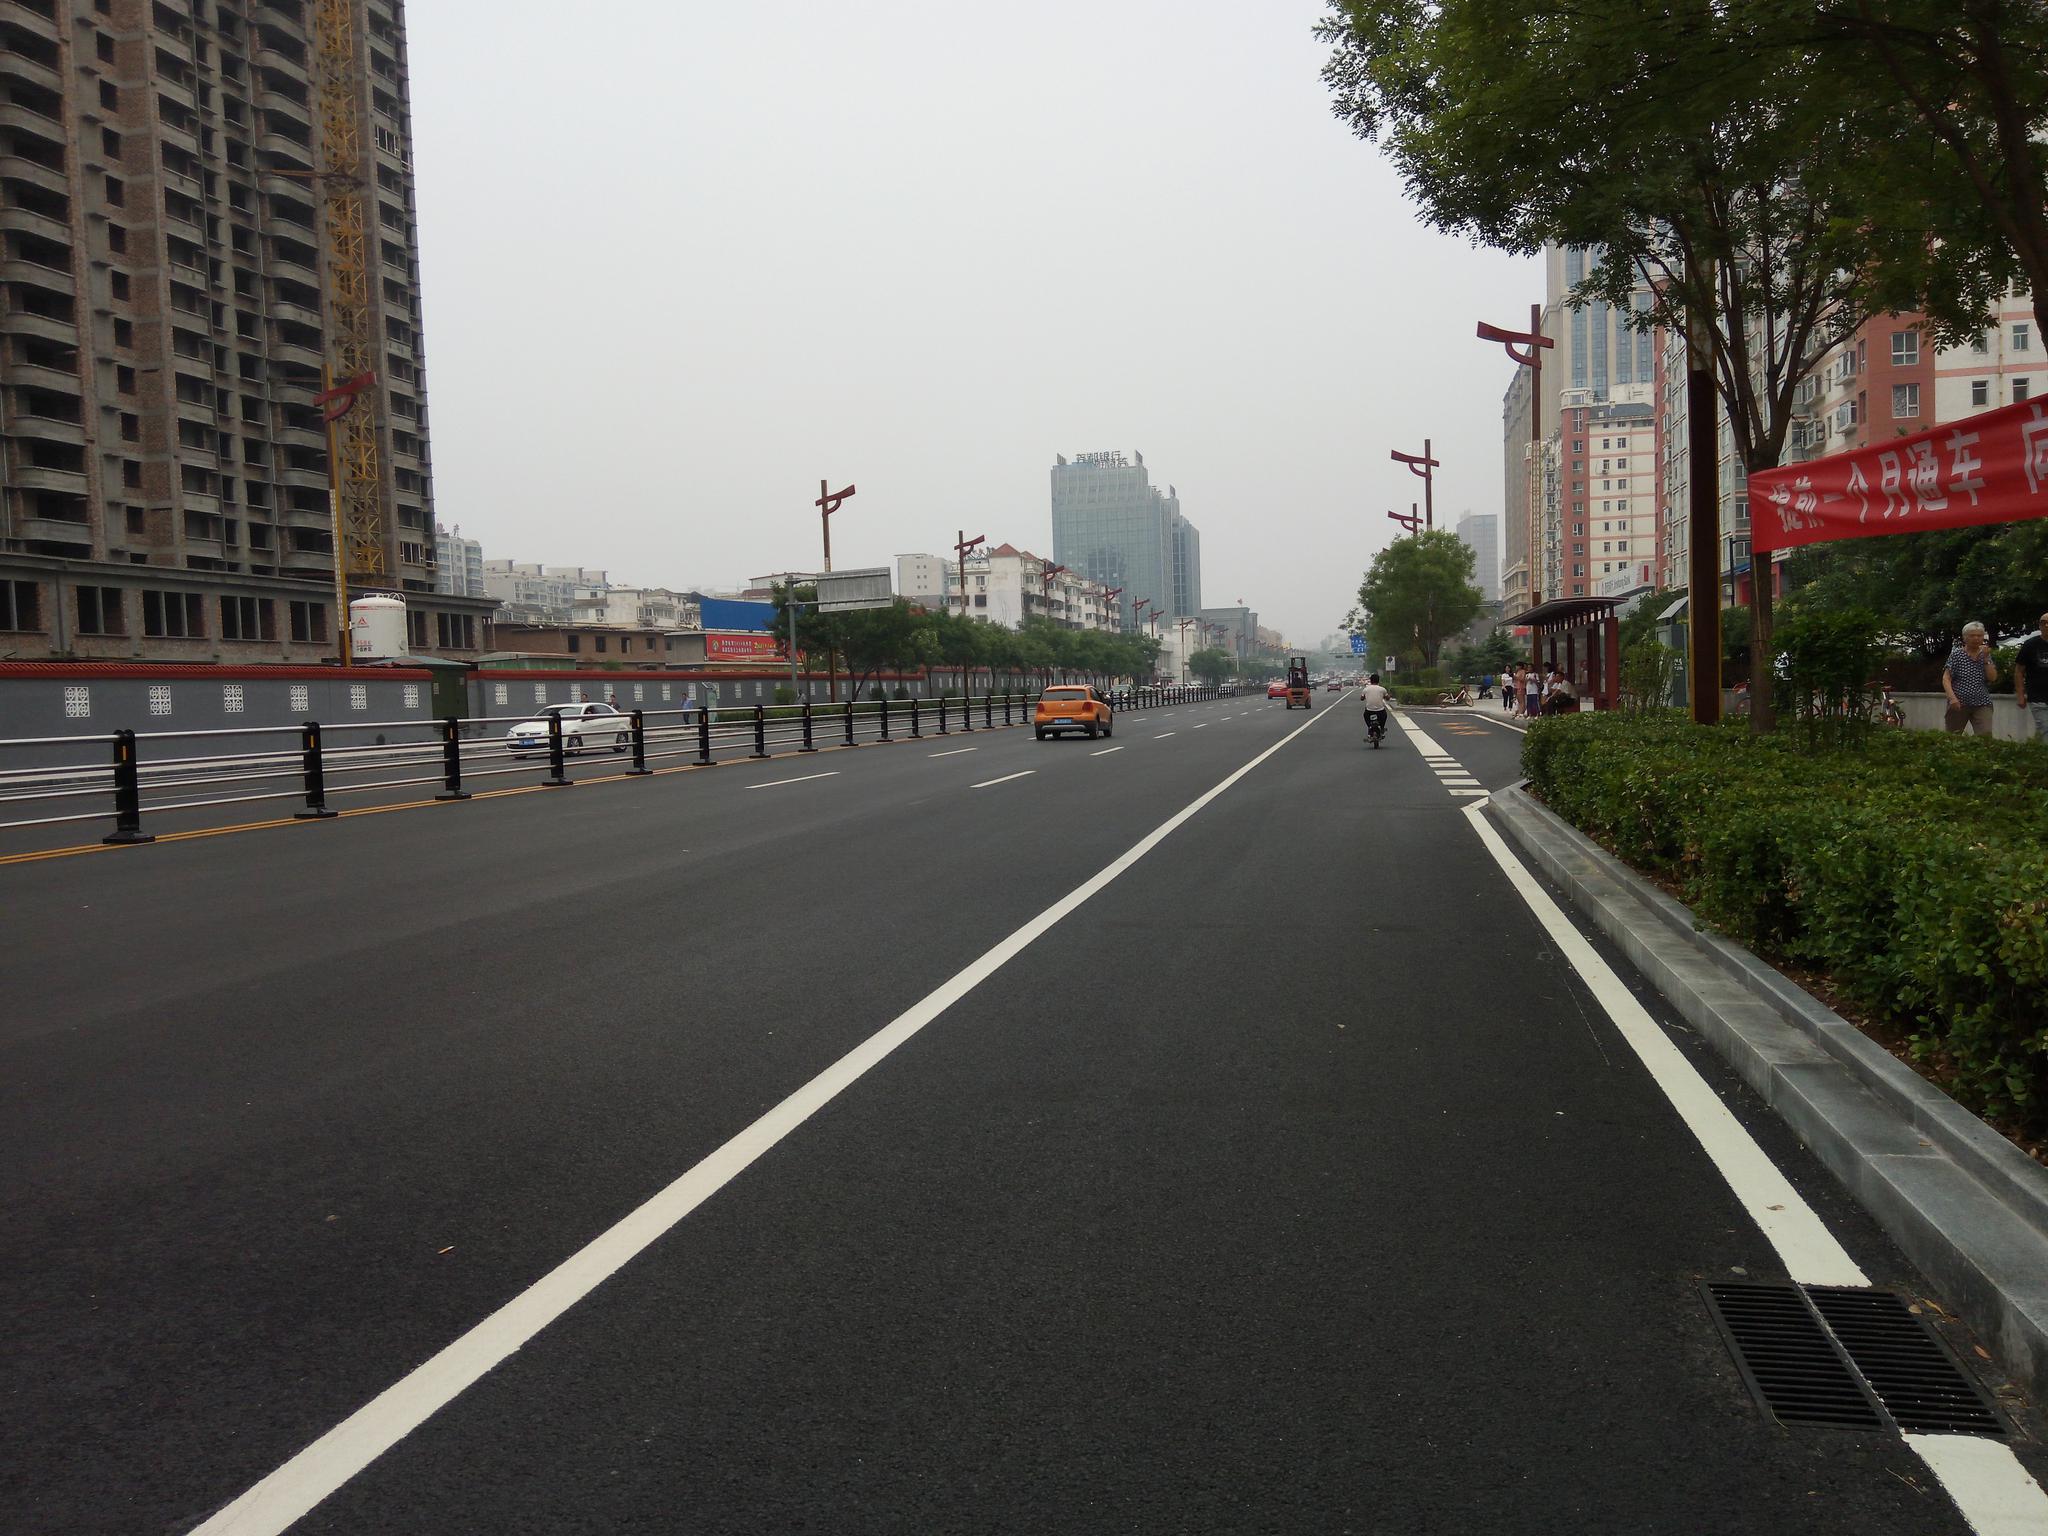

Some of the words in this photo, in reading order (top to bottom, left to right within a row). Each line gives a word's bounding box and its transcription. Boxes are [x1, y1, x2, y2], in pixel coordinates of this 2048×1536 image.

[1768, 429, 1986, 534] 提前一个月通车
